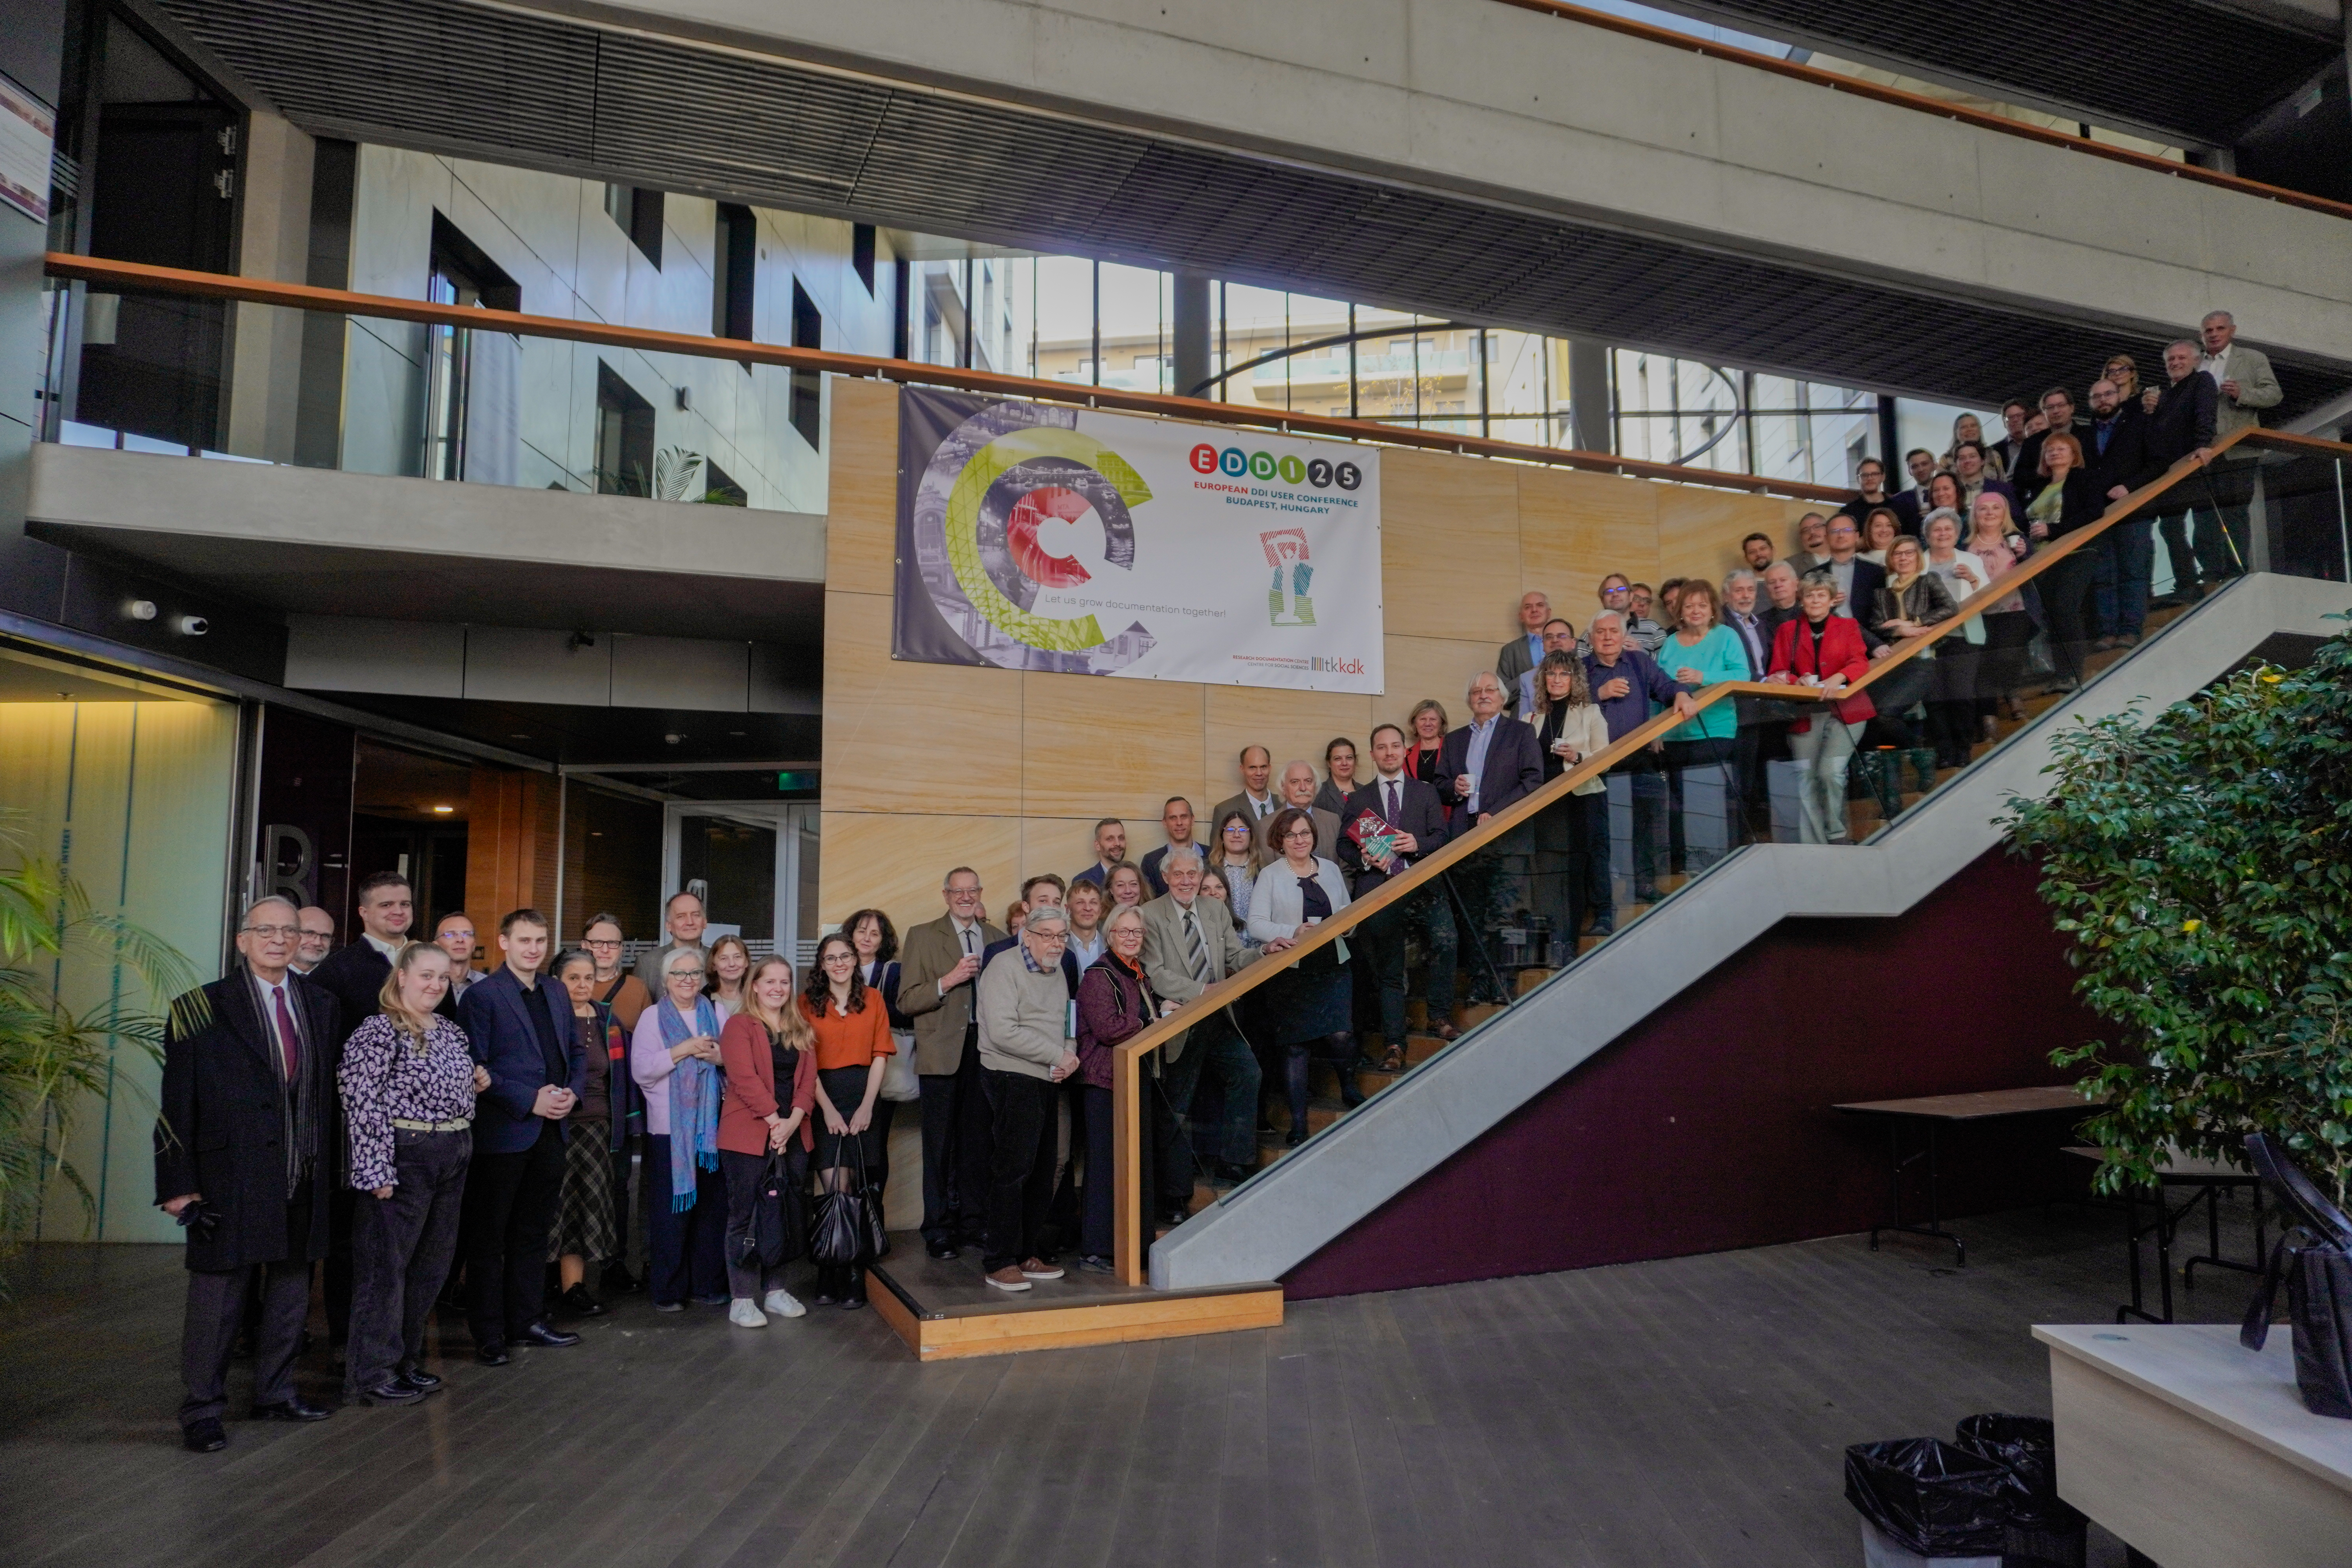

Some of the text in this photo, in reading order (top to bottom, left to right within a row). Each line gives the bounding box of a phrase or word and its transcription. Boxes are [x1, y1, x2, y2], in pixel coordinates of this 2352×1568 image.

[1194, 481, 1358, 507] EUROPEAN DDI USER CONFERENCE
[1226, 496, 1330, 514] BUDAPEST, HUNGARY
[1045, 594, 1061, 603] Let
[1079, 598, 1103, 607] grow
[1105, 600, 1180, 614] documentation
[1183, 607, 1226, 617] together!
